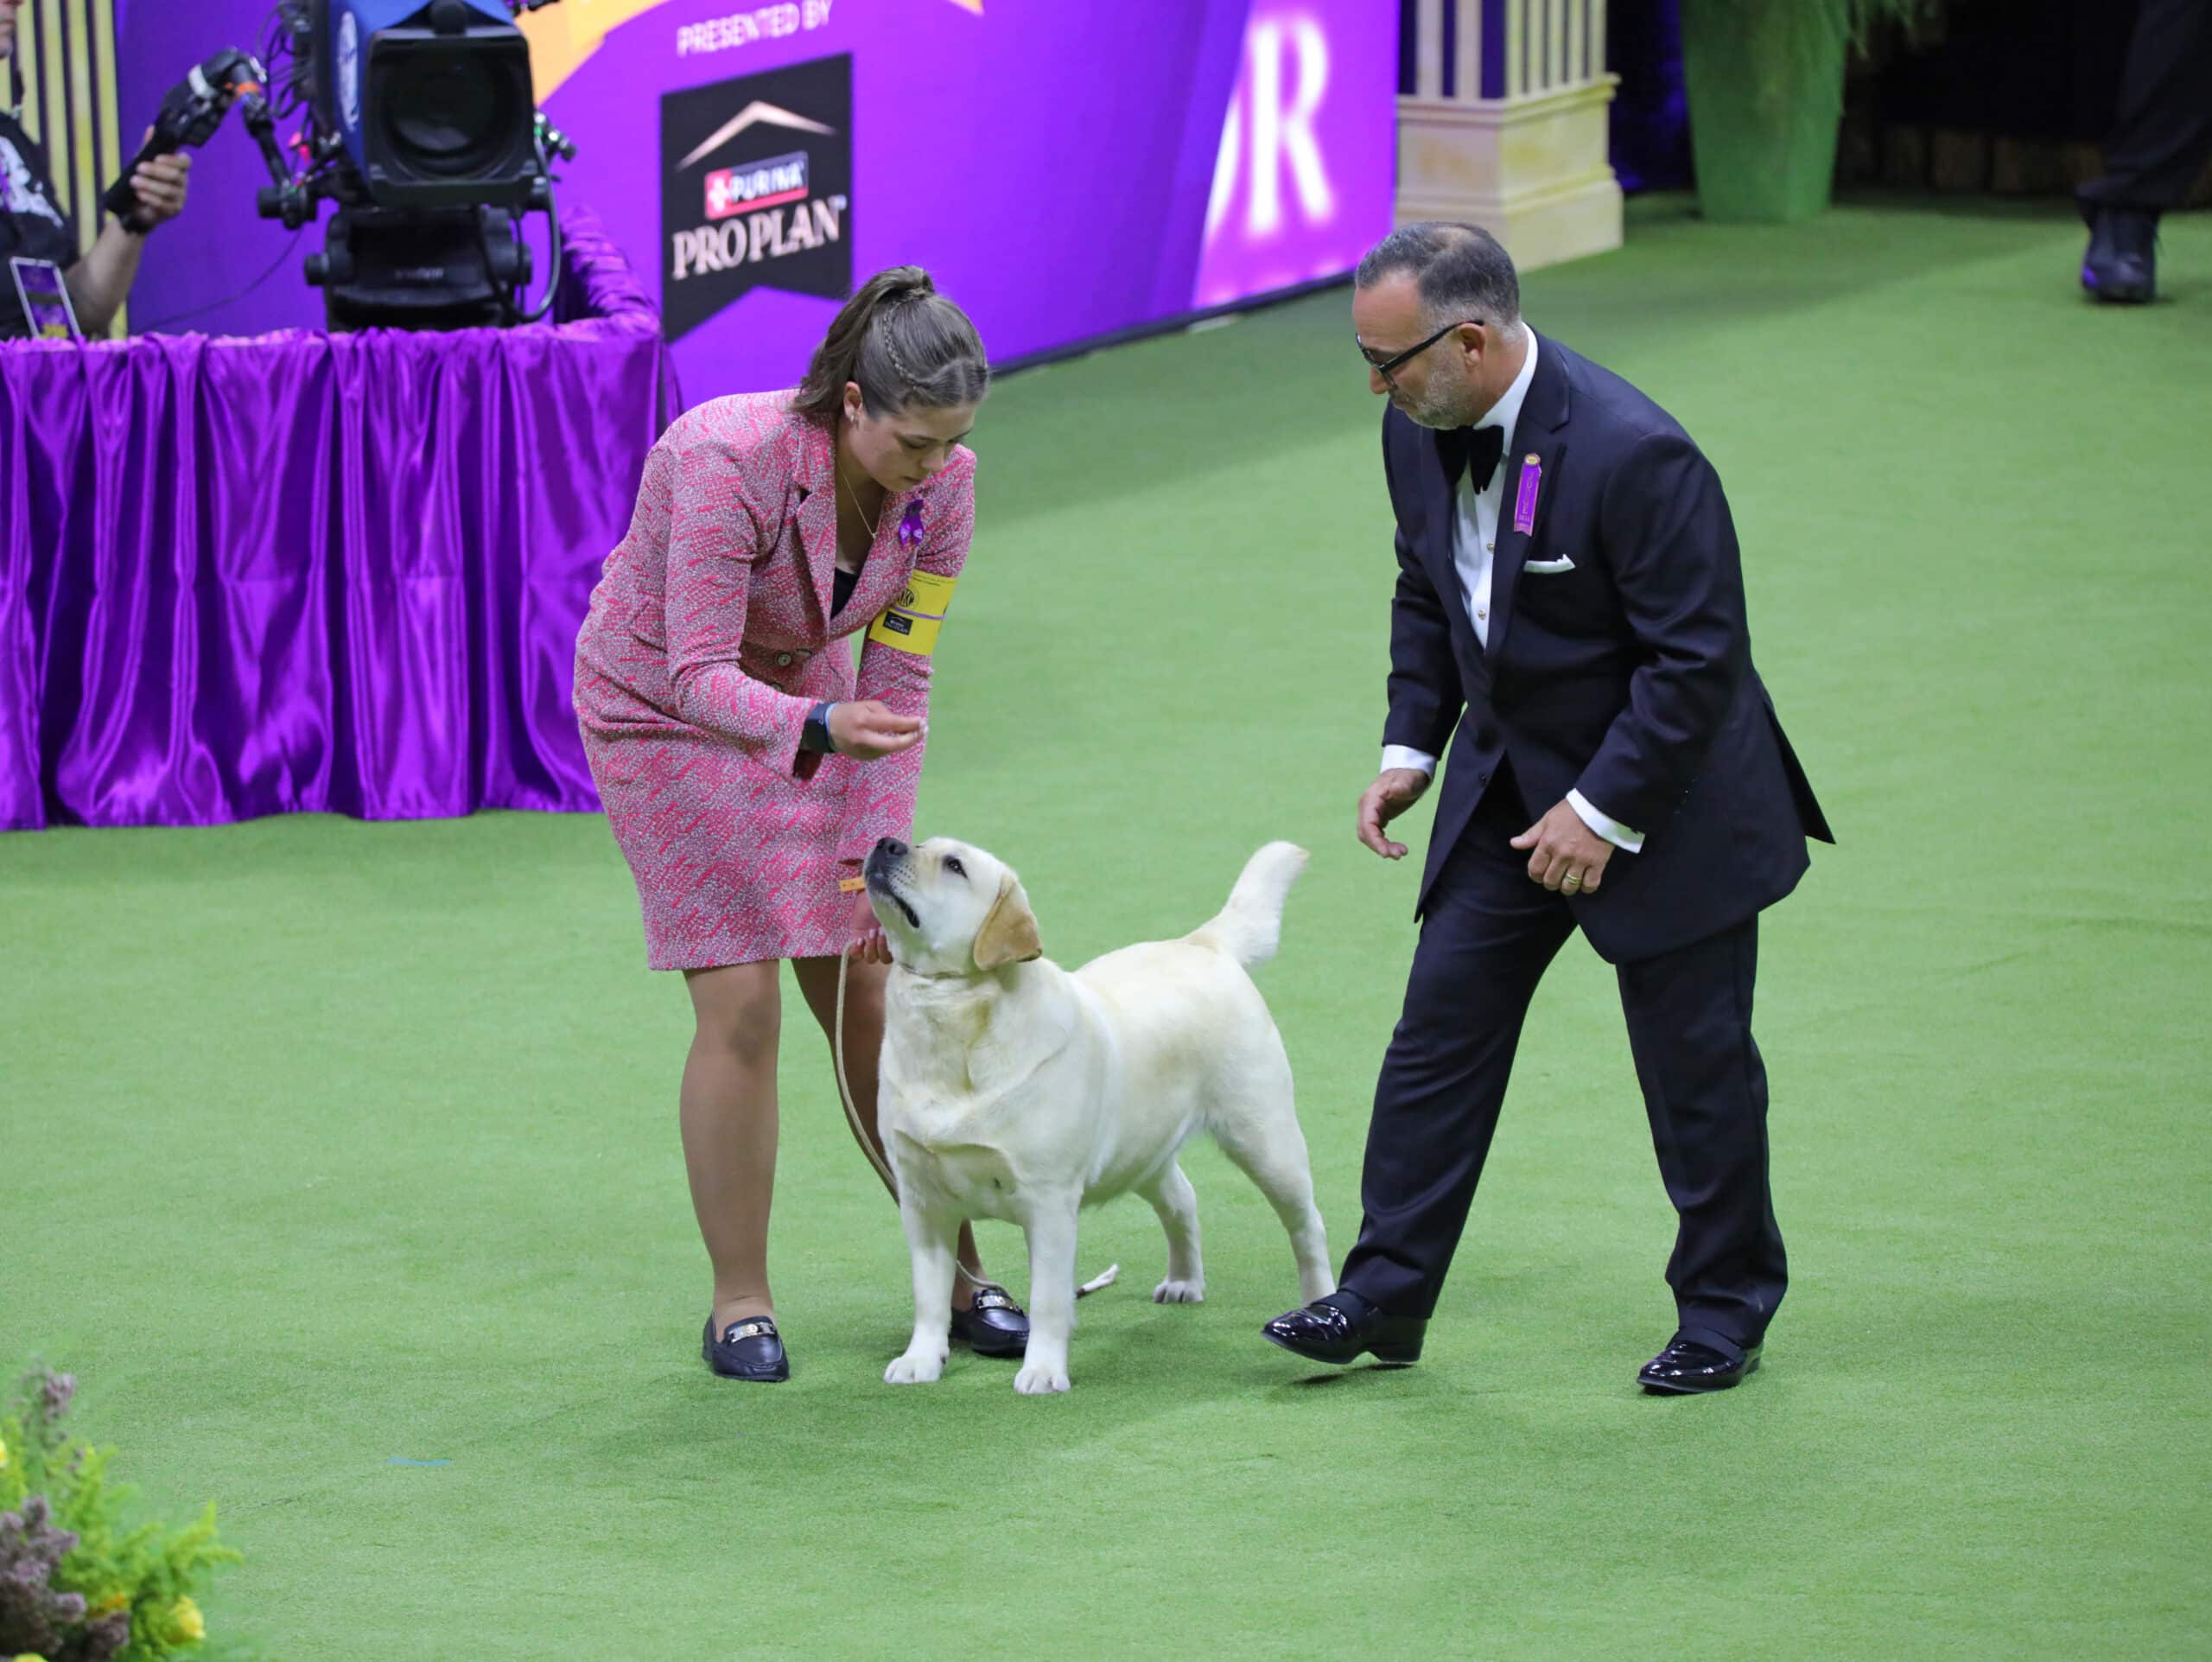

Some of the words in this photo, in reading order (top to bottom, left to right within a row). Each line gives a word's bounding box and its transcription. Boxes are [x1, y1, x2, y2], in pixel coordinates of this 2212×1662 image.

[677, 2, 800, 57] PRESENTED
[801, 0, 833, 30] BY
[729, 162, 804, 203] PURINA
[672, 218, 747, 281] PRO
[747, 198, 840, 262] PLAN
